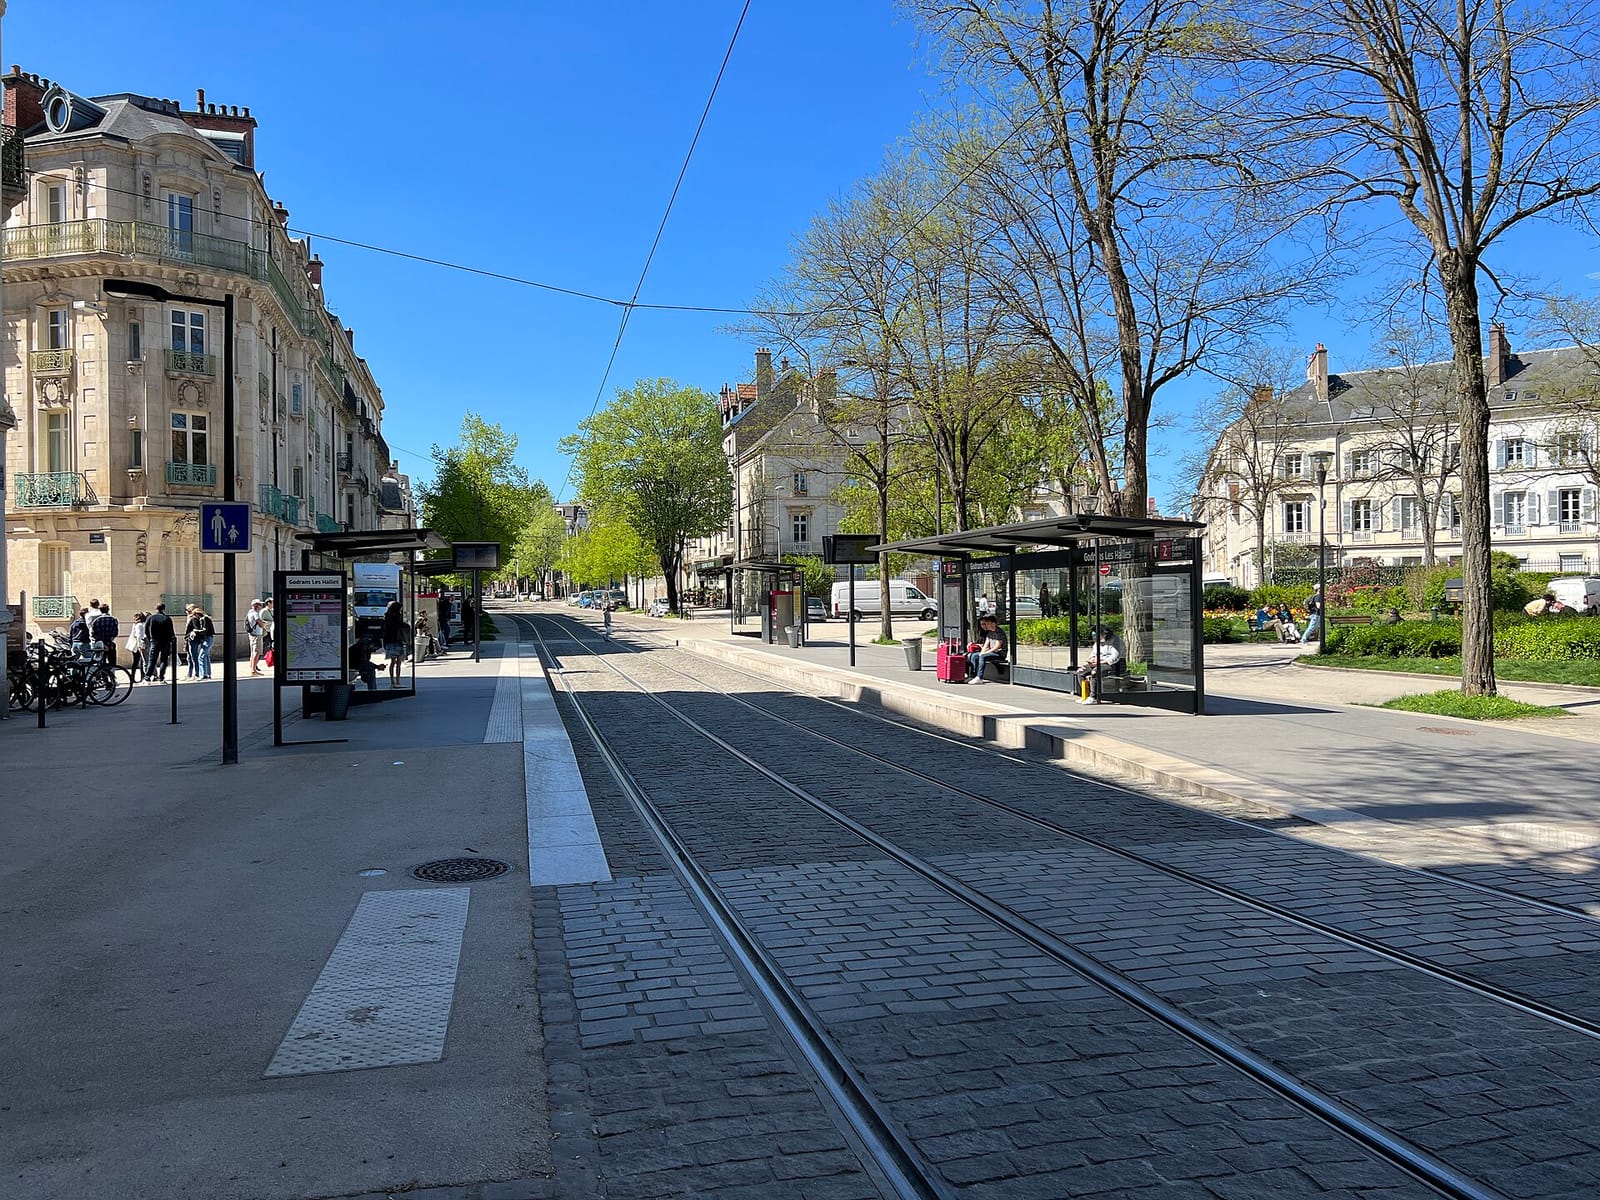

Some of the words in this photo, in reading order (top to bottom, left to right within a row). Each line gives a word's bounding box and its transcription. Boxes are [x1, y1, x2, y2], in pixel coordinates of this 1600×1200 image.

[1083, 552, 1104, 561] Godrns
[1105, 551, 1114, 560] Les
[1114, 549, 1132, 560] Halles
[1153, 546, 1159, 558] T
[1162, 545, 1168, 557] 2
